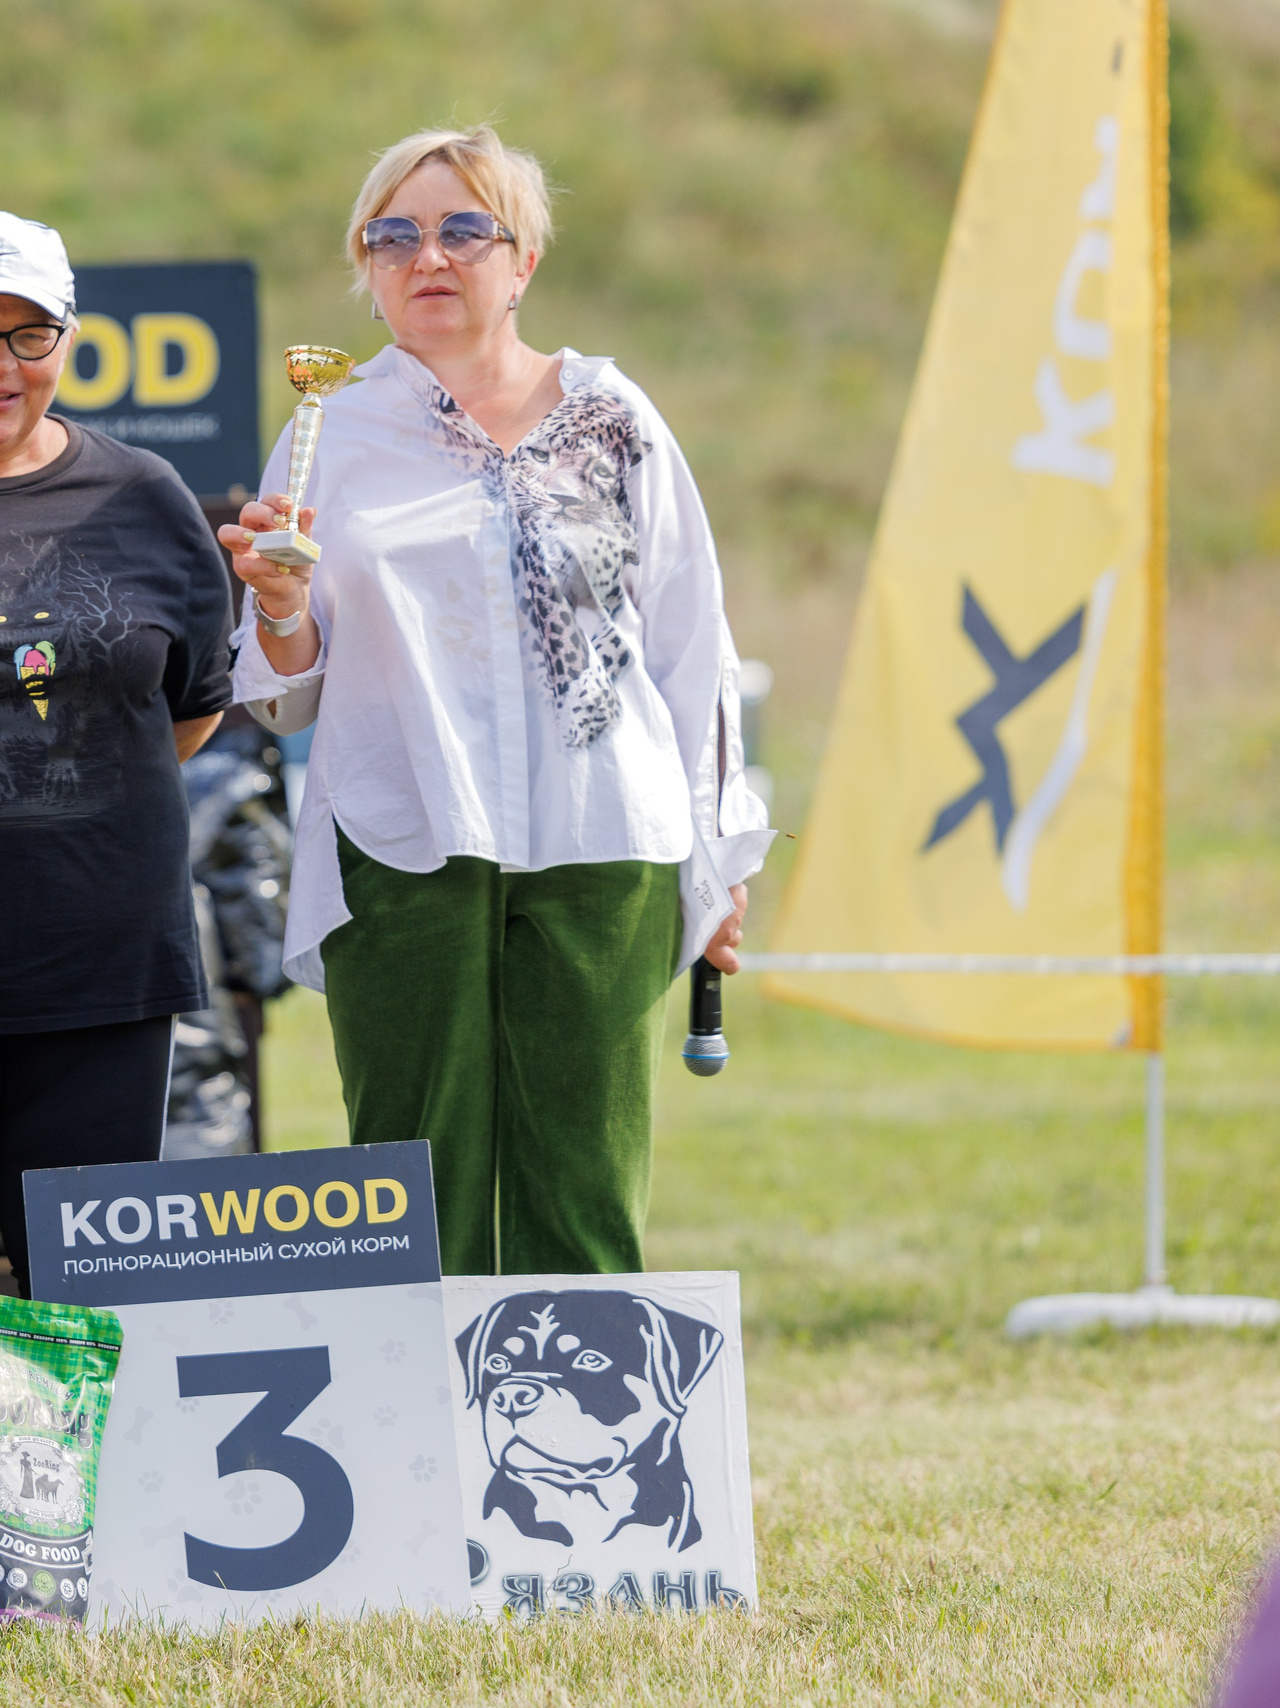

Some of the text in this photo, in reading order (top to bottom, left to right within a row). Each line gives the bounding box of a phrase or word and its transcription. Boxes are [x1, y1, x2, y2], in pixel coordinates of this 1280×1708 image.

[60, 1178, 408, 1247] KORWOOD
[63, 1234, 410, 1275] ПОЛНОРАЦИОННЫЙ СУХОЙ КОРМ
[19, 1367, 75, 1401] PREMIUM
[176, 1345, 355, 1592] 3
[40, 1545, 80, 1562] FOOD
